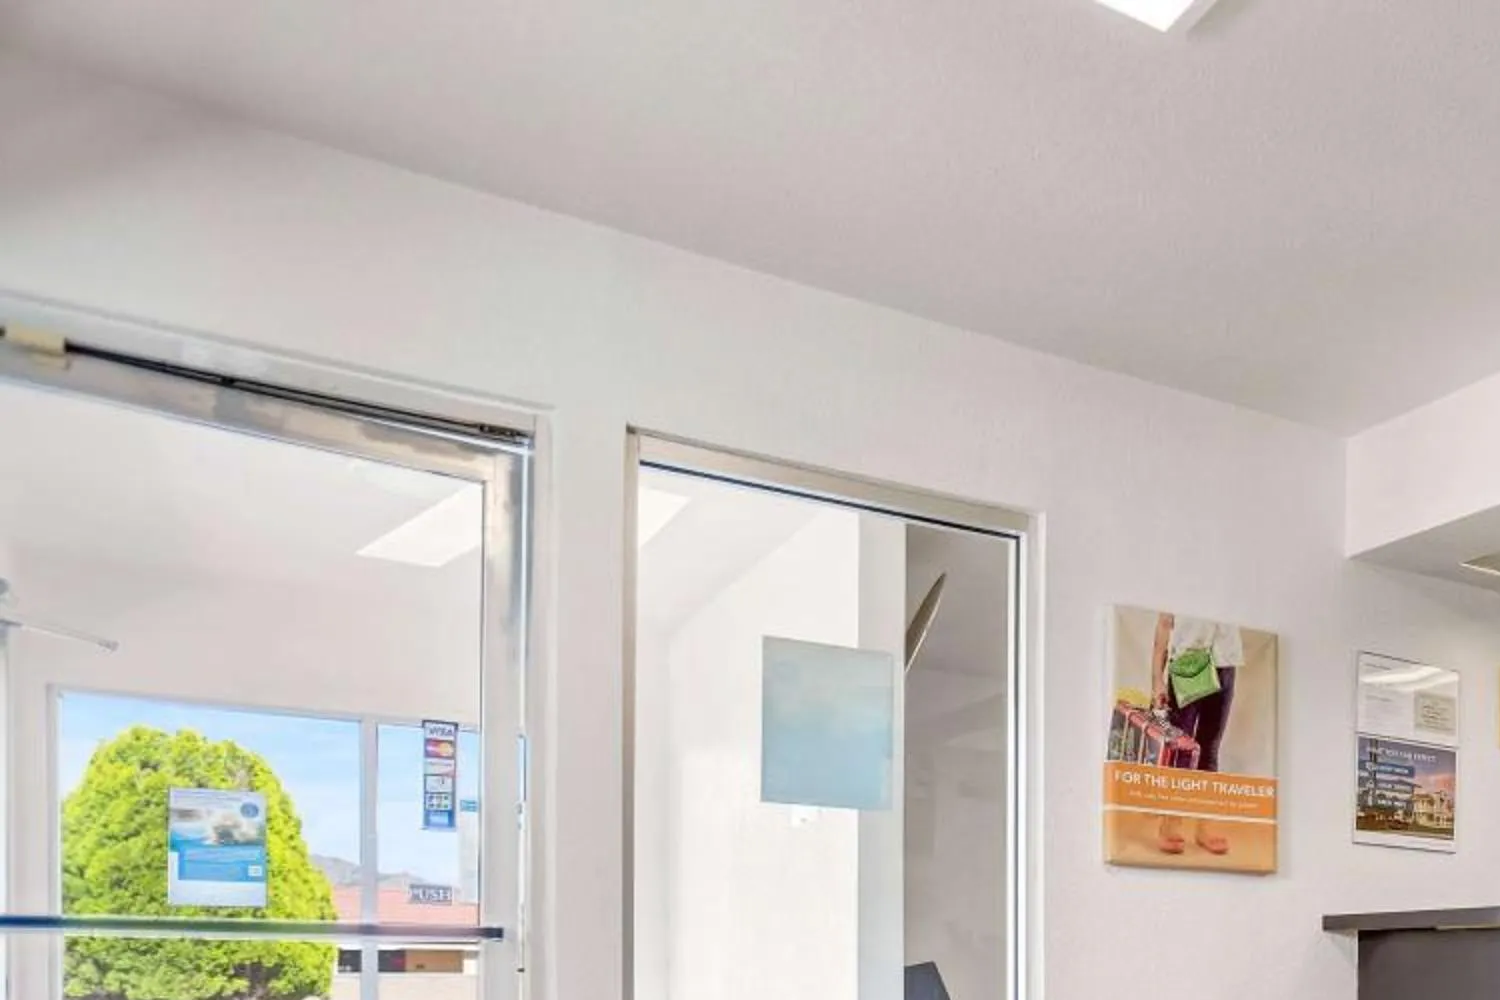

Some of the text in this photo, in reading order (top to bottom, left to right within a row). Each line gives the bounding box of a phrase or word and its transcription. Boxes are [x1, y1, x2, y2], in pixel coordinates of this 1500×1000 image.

[1115, 771, 1275, 798] FOR THE LIGHT TRAVELER
[411, 887, 450, 900] PUSH
